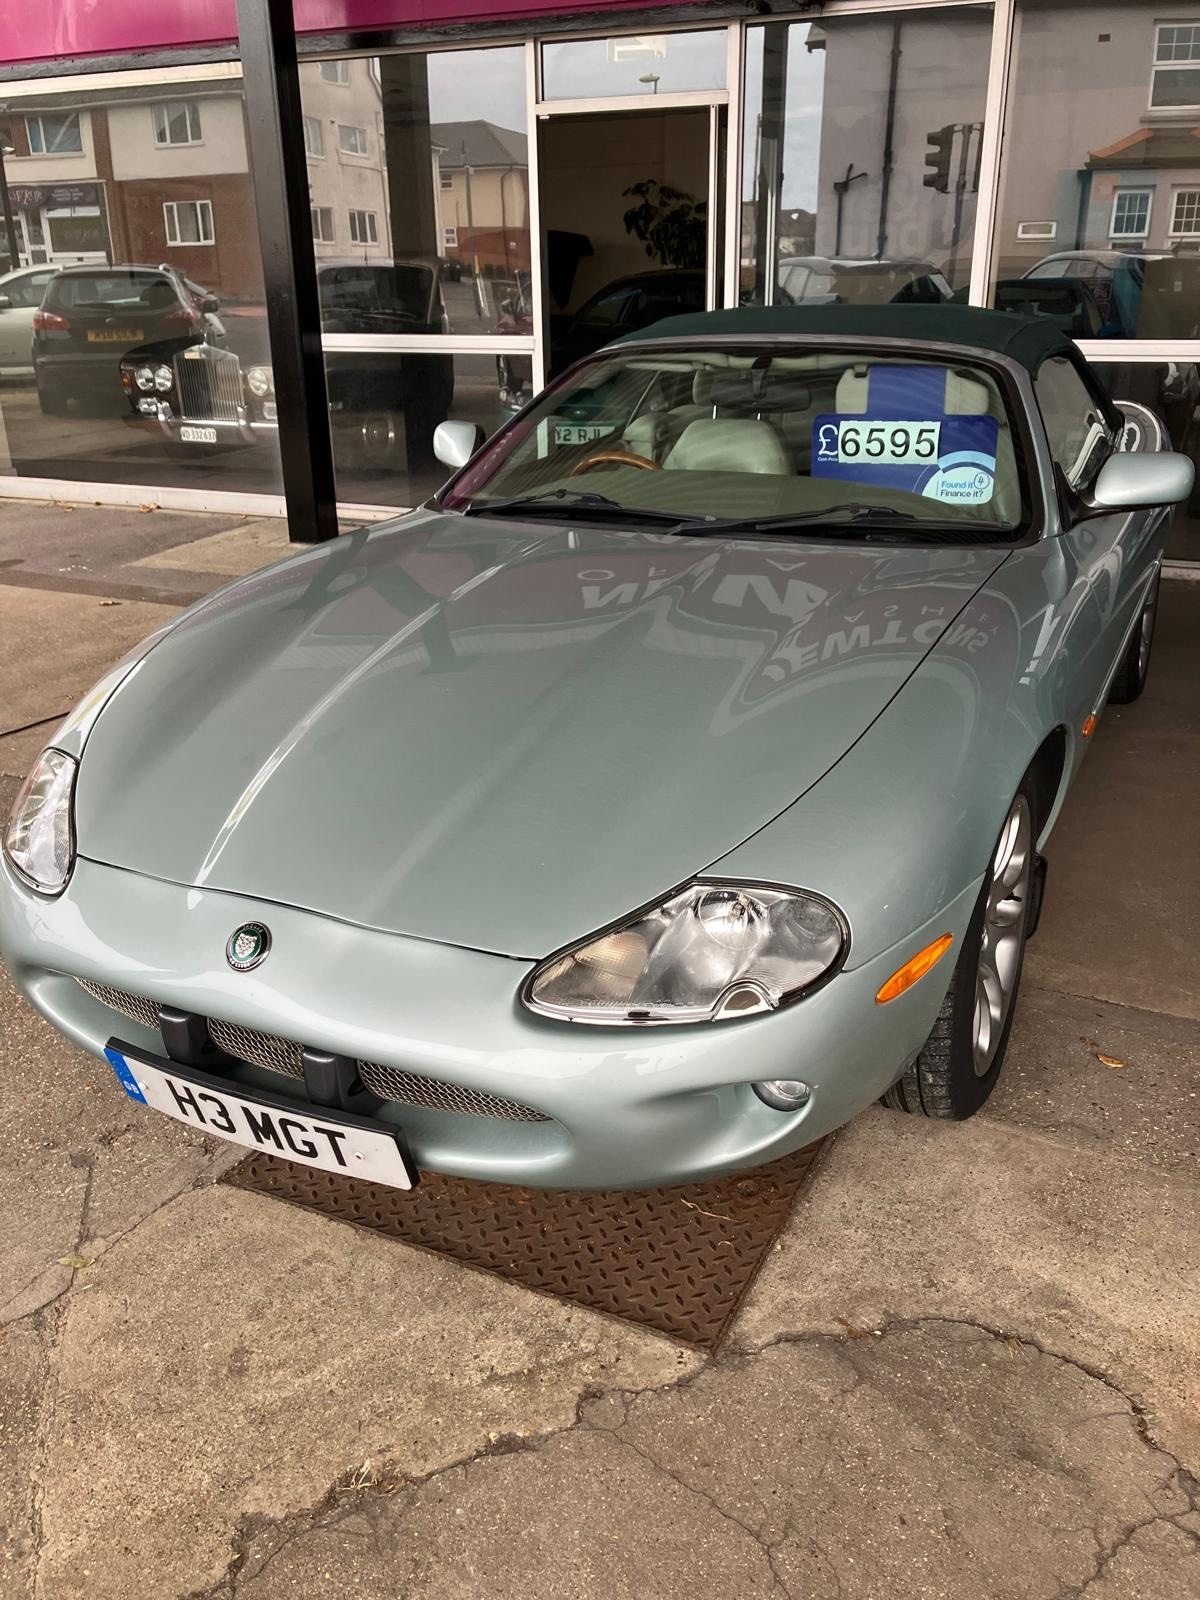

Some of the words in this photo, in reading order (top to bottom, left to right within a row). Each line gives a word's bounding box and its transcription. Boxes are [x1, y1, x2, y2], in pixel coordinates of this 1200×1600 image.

[941, 480, 967, 489] Found
[940, 489, 972, 498] Finance
[973, 489, 984, 498] it?
[123, 1080, 140, 1095] GB
[164, 1078, 237, 1134] H3
[240, 1105, 348, 1167] MGT
